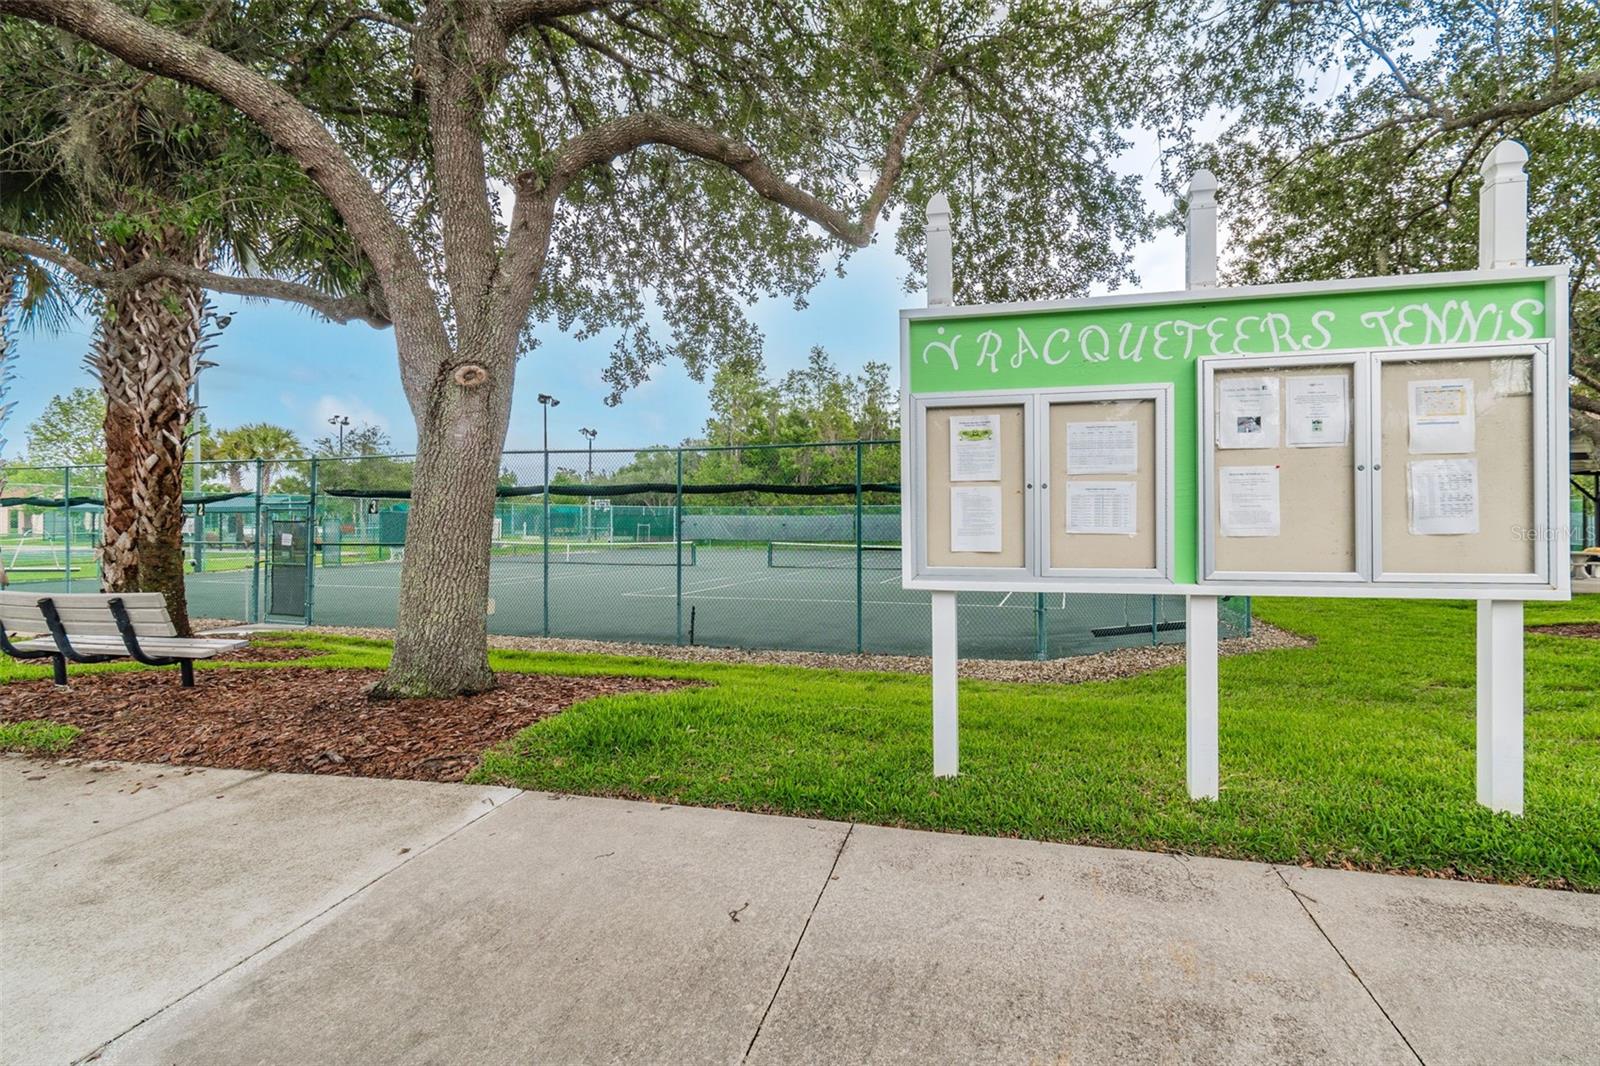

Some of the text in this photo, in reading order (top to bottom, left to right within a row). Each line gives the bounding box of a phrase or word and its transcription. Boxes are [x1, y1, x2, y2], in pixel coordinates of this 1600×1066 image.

[976, 310, 1335, 373] RACQUETEERS
[198, 503, 204, 516] 2
[370, 500, 376, 513] 3
